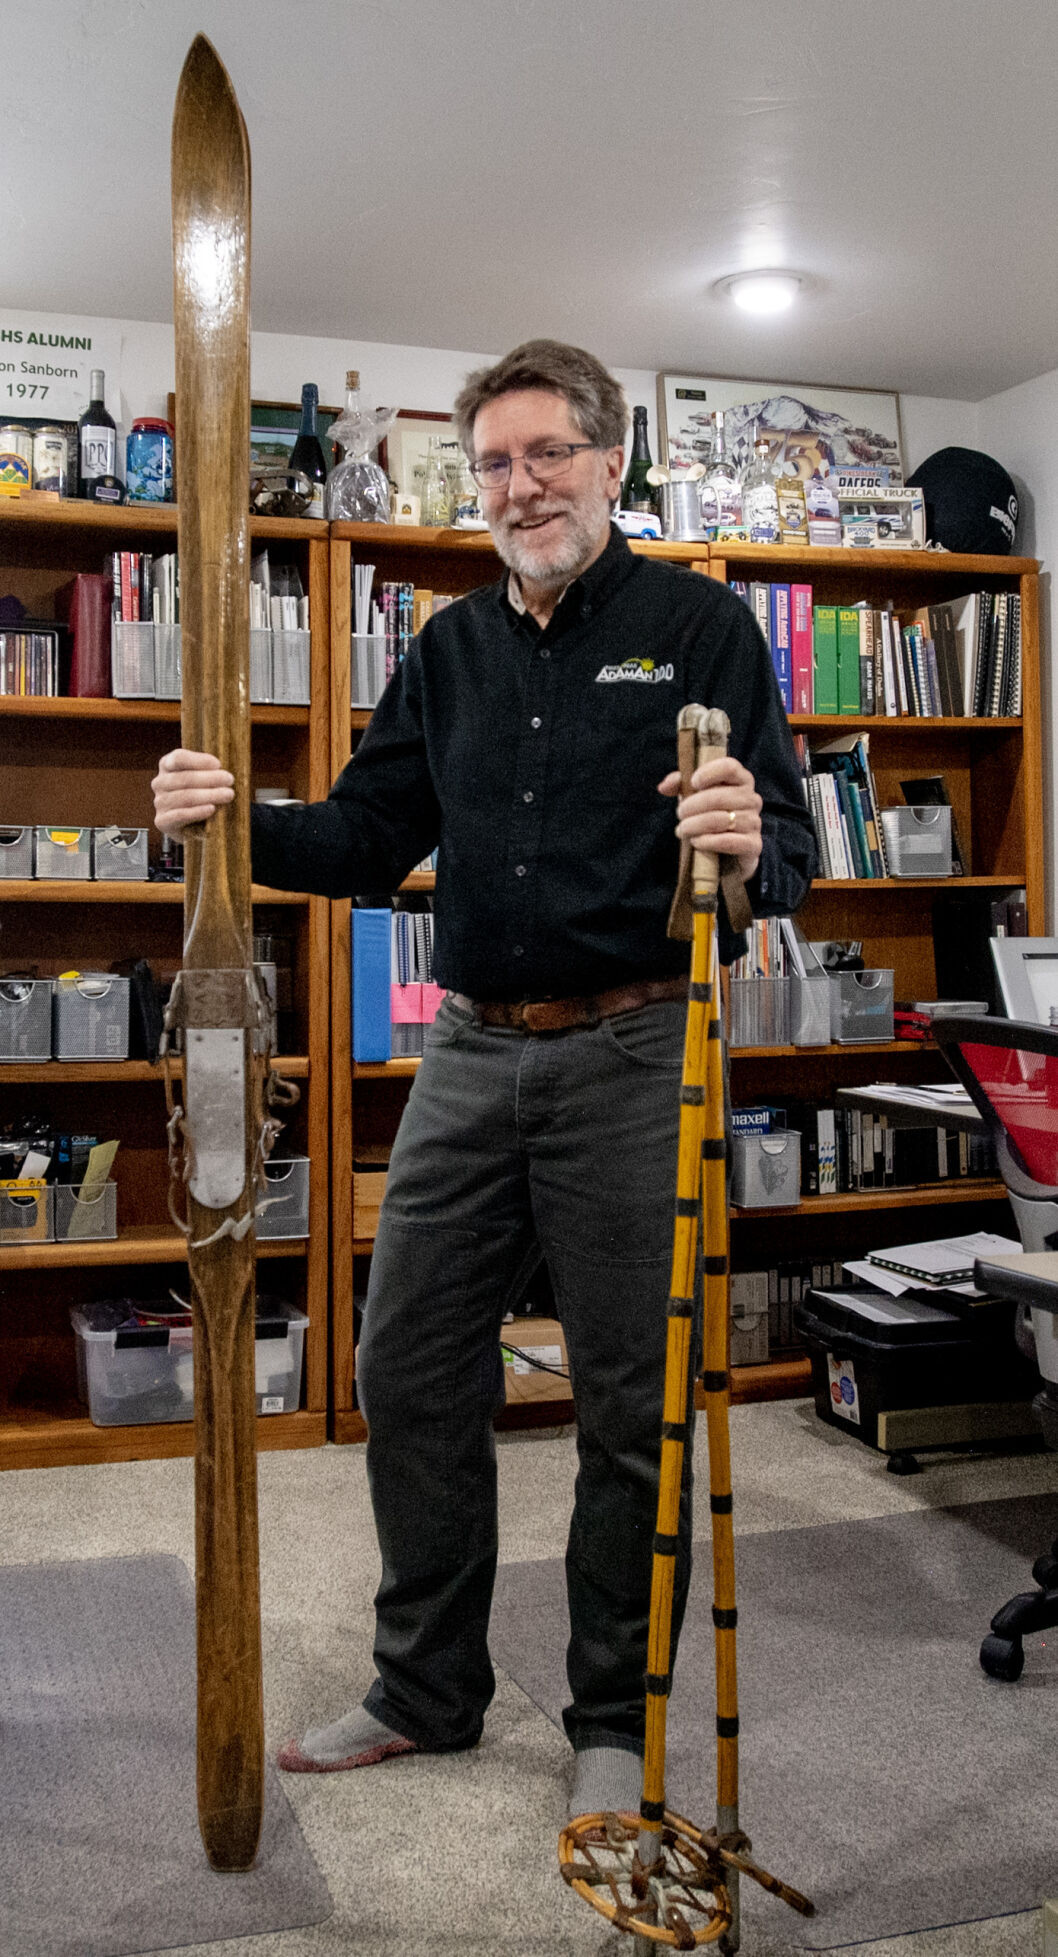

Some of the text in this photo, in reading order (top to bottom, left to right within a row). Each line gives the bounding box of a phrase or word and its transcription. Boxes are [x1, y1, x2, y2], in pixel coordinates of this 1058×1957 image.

[1, 329, 92, 351] HS ALUMNI
[20, 361, 79, 379] Sanborn
[6, 383, 50, 400] 1977
[838, 487, 880, 498] FFICIAL
[883, 489, 918, 498] TRUCK
[817, 609, 836, 619] IDA
[840, 611, 858, 622] IDA
